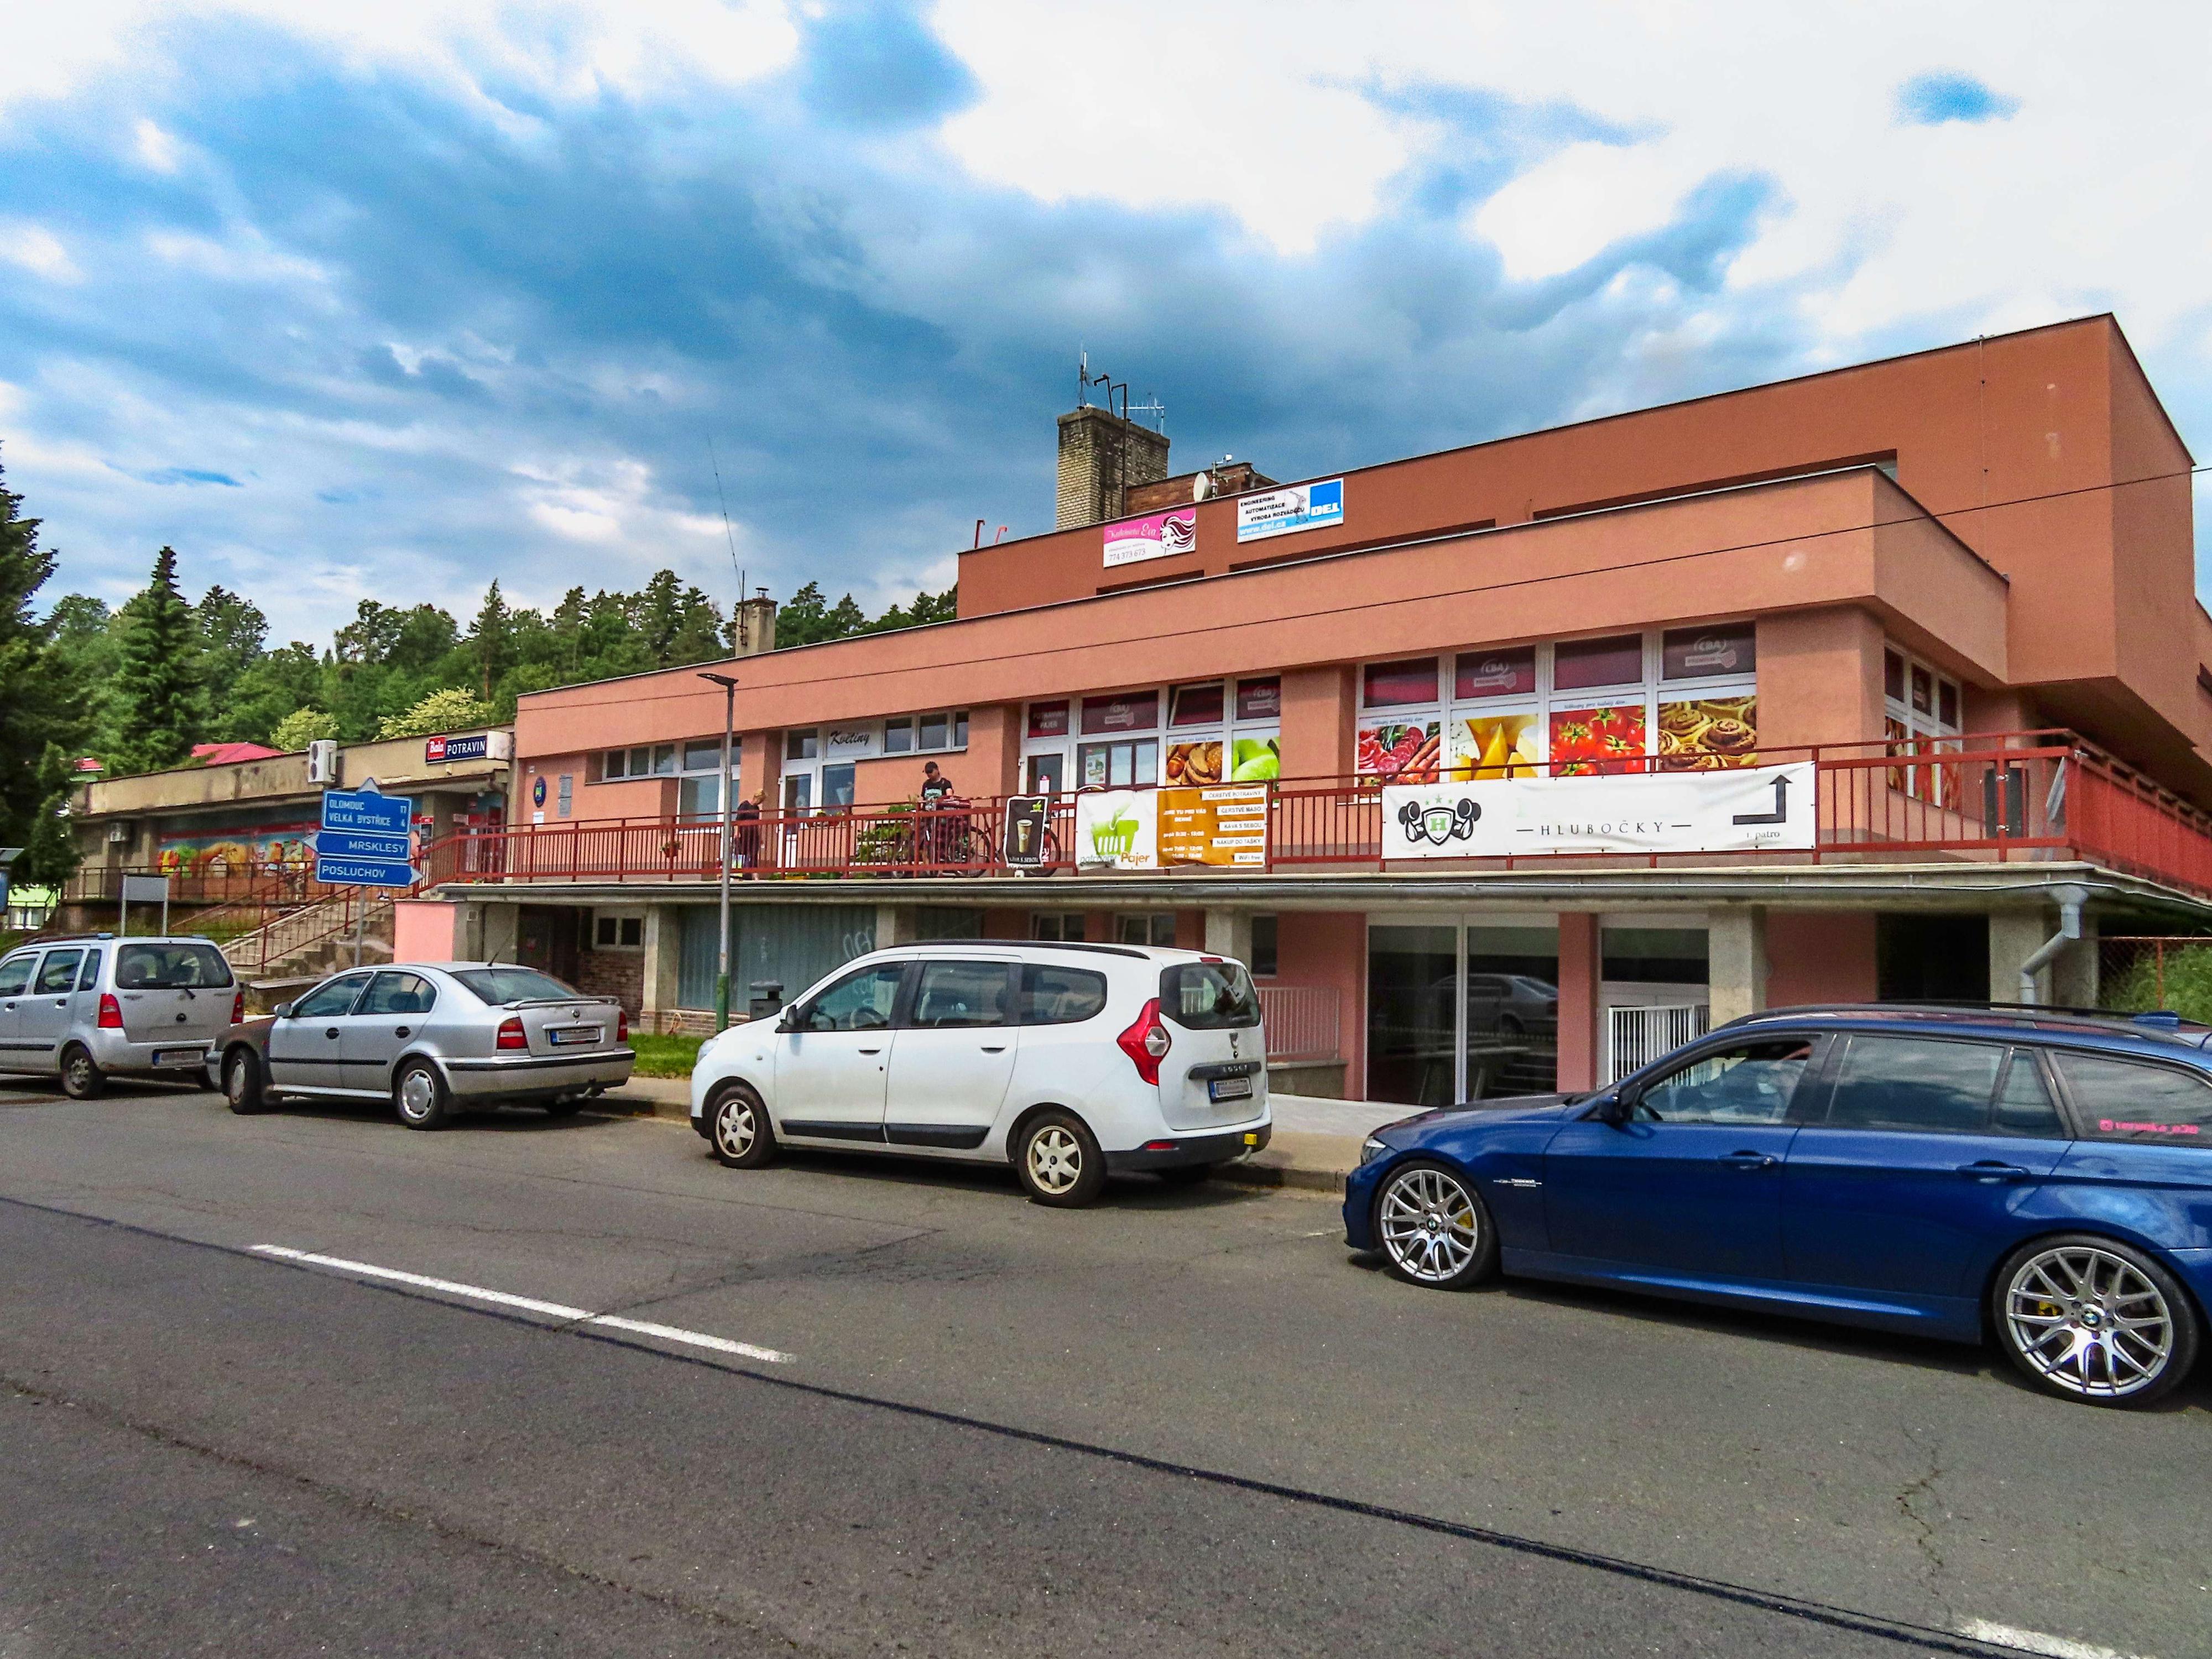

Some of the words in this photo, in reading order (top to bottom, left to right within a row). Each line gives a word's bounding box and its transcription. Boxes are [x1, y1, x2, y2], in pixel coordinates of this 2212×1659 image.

[1245, 503, 1285, 514] AUTOMATIZACE
[1311, 502, 1339, 517] DEL
[1239, 521, 1286, 536] www.del.cz
[447, 741, 486, 755] POTRAVIN
[329, 799, 365, 811] OLOMOUC
[329, 812, 353, 823] VELKÁ
[1430, 818, 1447, 832] H
[1541, 820, 1663, 835] HLUBOČKY
[1755, 831, 1780, 840] patro
[348, 841, 405, 853] MRSKLESY
[1120, 852, 1150, 866] Pajer
[322, 865, 386, 878] POSLUCHOV
